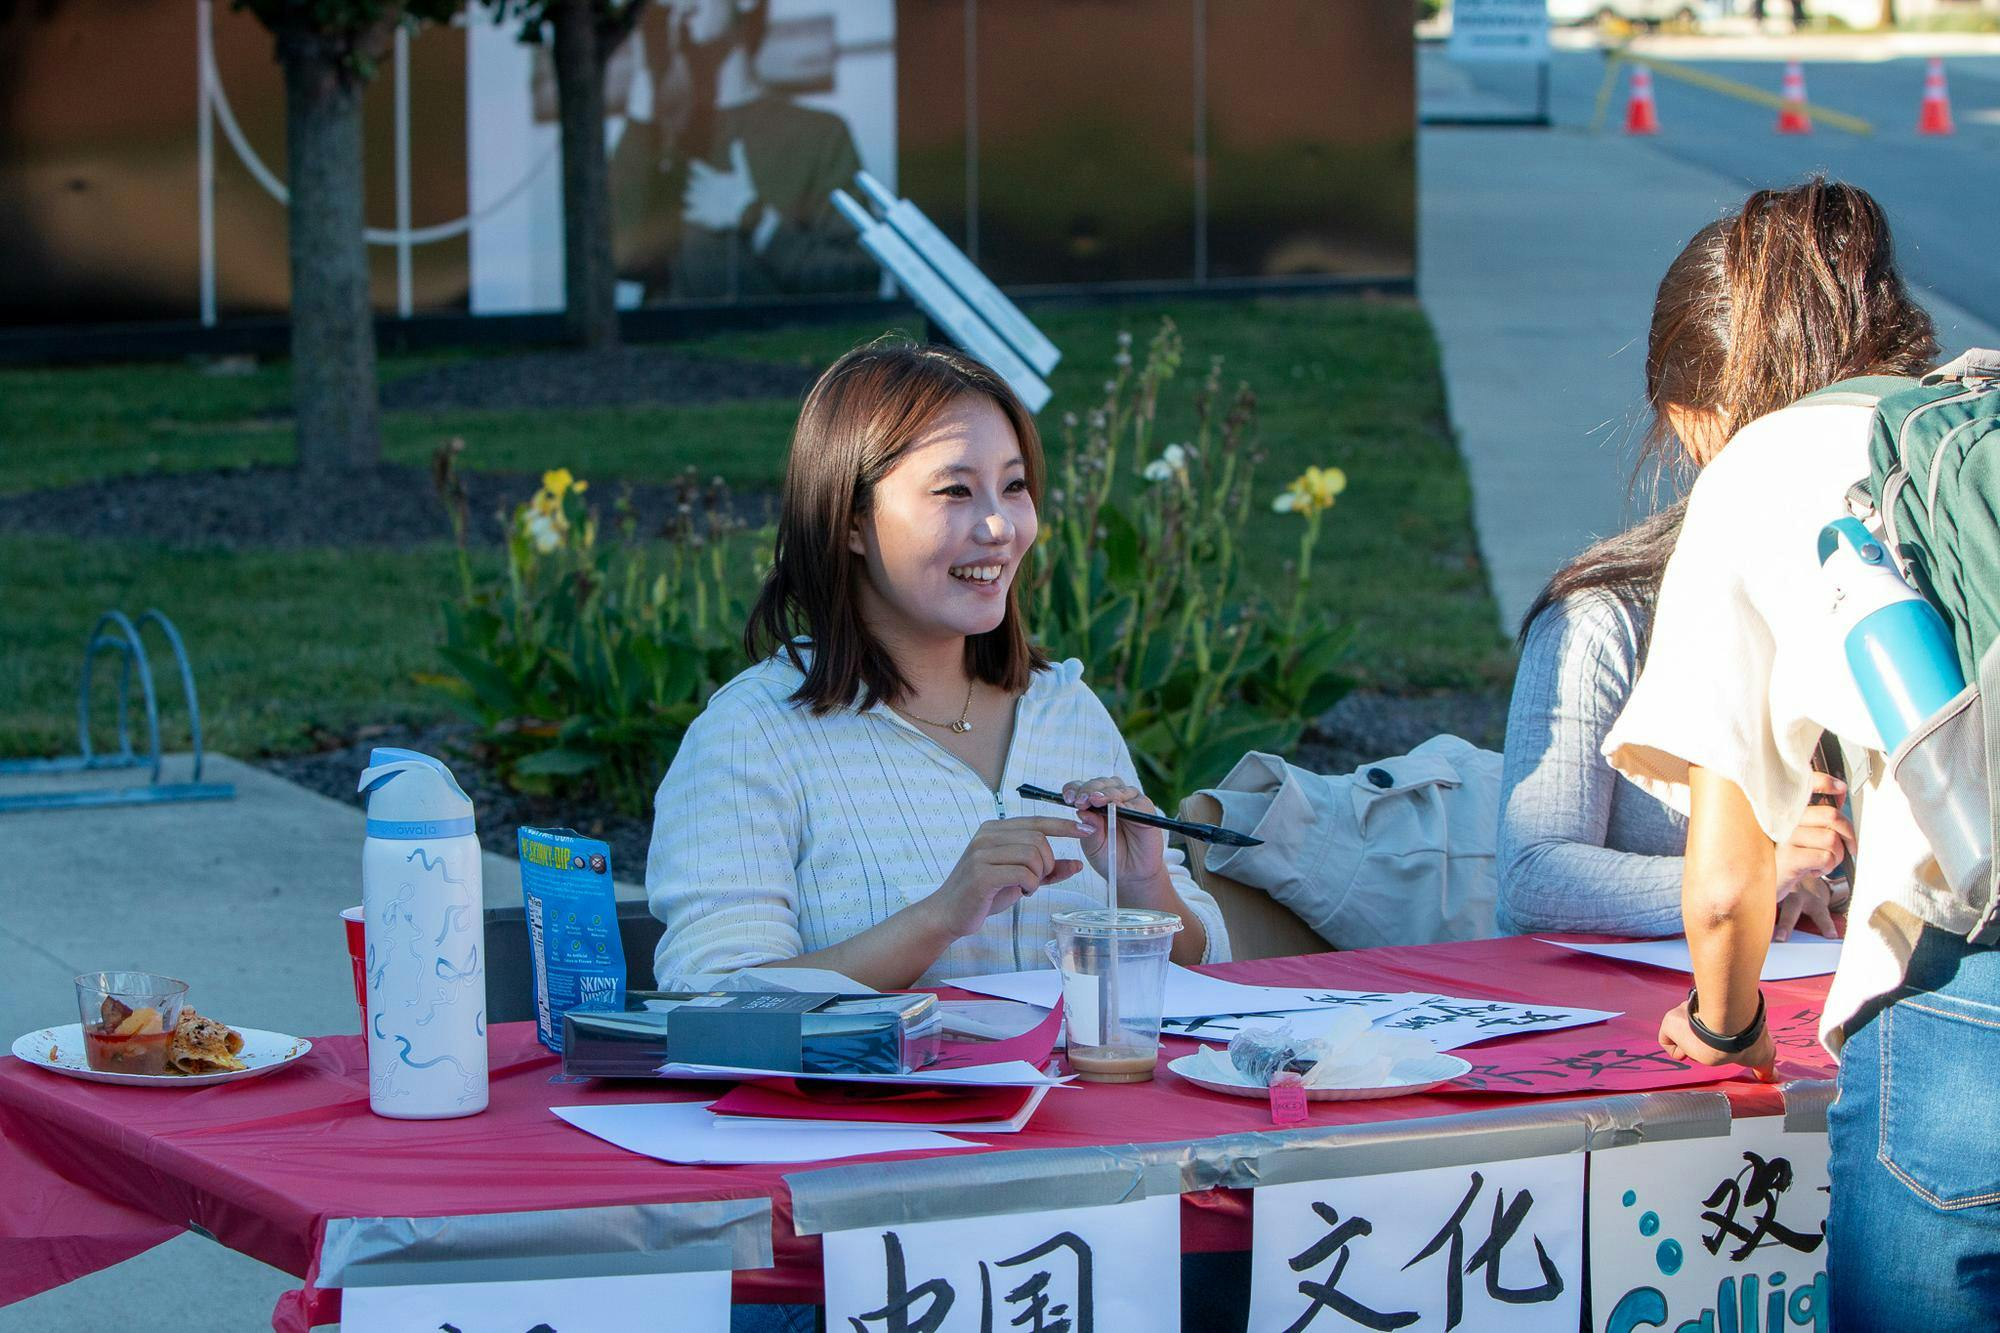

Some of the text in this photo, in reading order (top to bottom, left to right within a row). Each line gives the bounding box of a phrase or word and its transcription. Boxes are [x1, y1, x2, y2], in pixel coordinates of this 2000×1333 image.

[396, 824, 437, 835] owala
[580, 976, 618, 992] SKINNY
[847, 1230, 1094, 1333] 中国
[1281, 1170, 1565, 1333] 文化
[1605, 1271, 1828, 1333] Cllig
